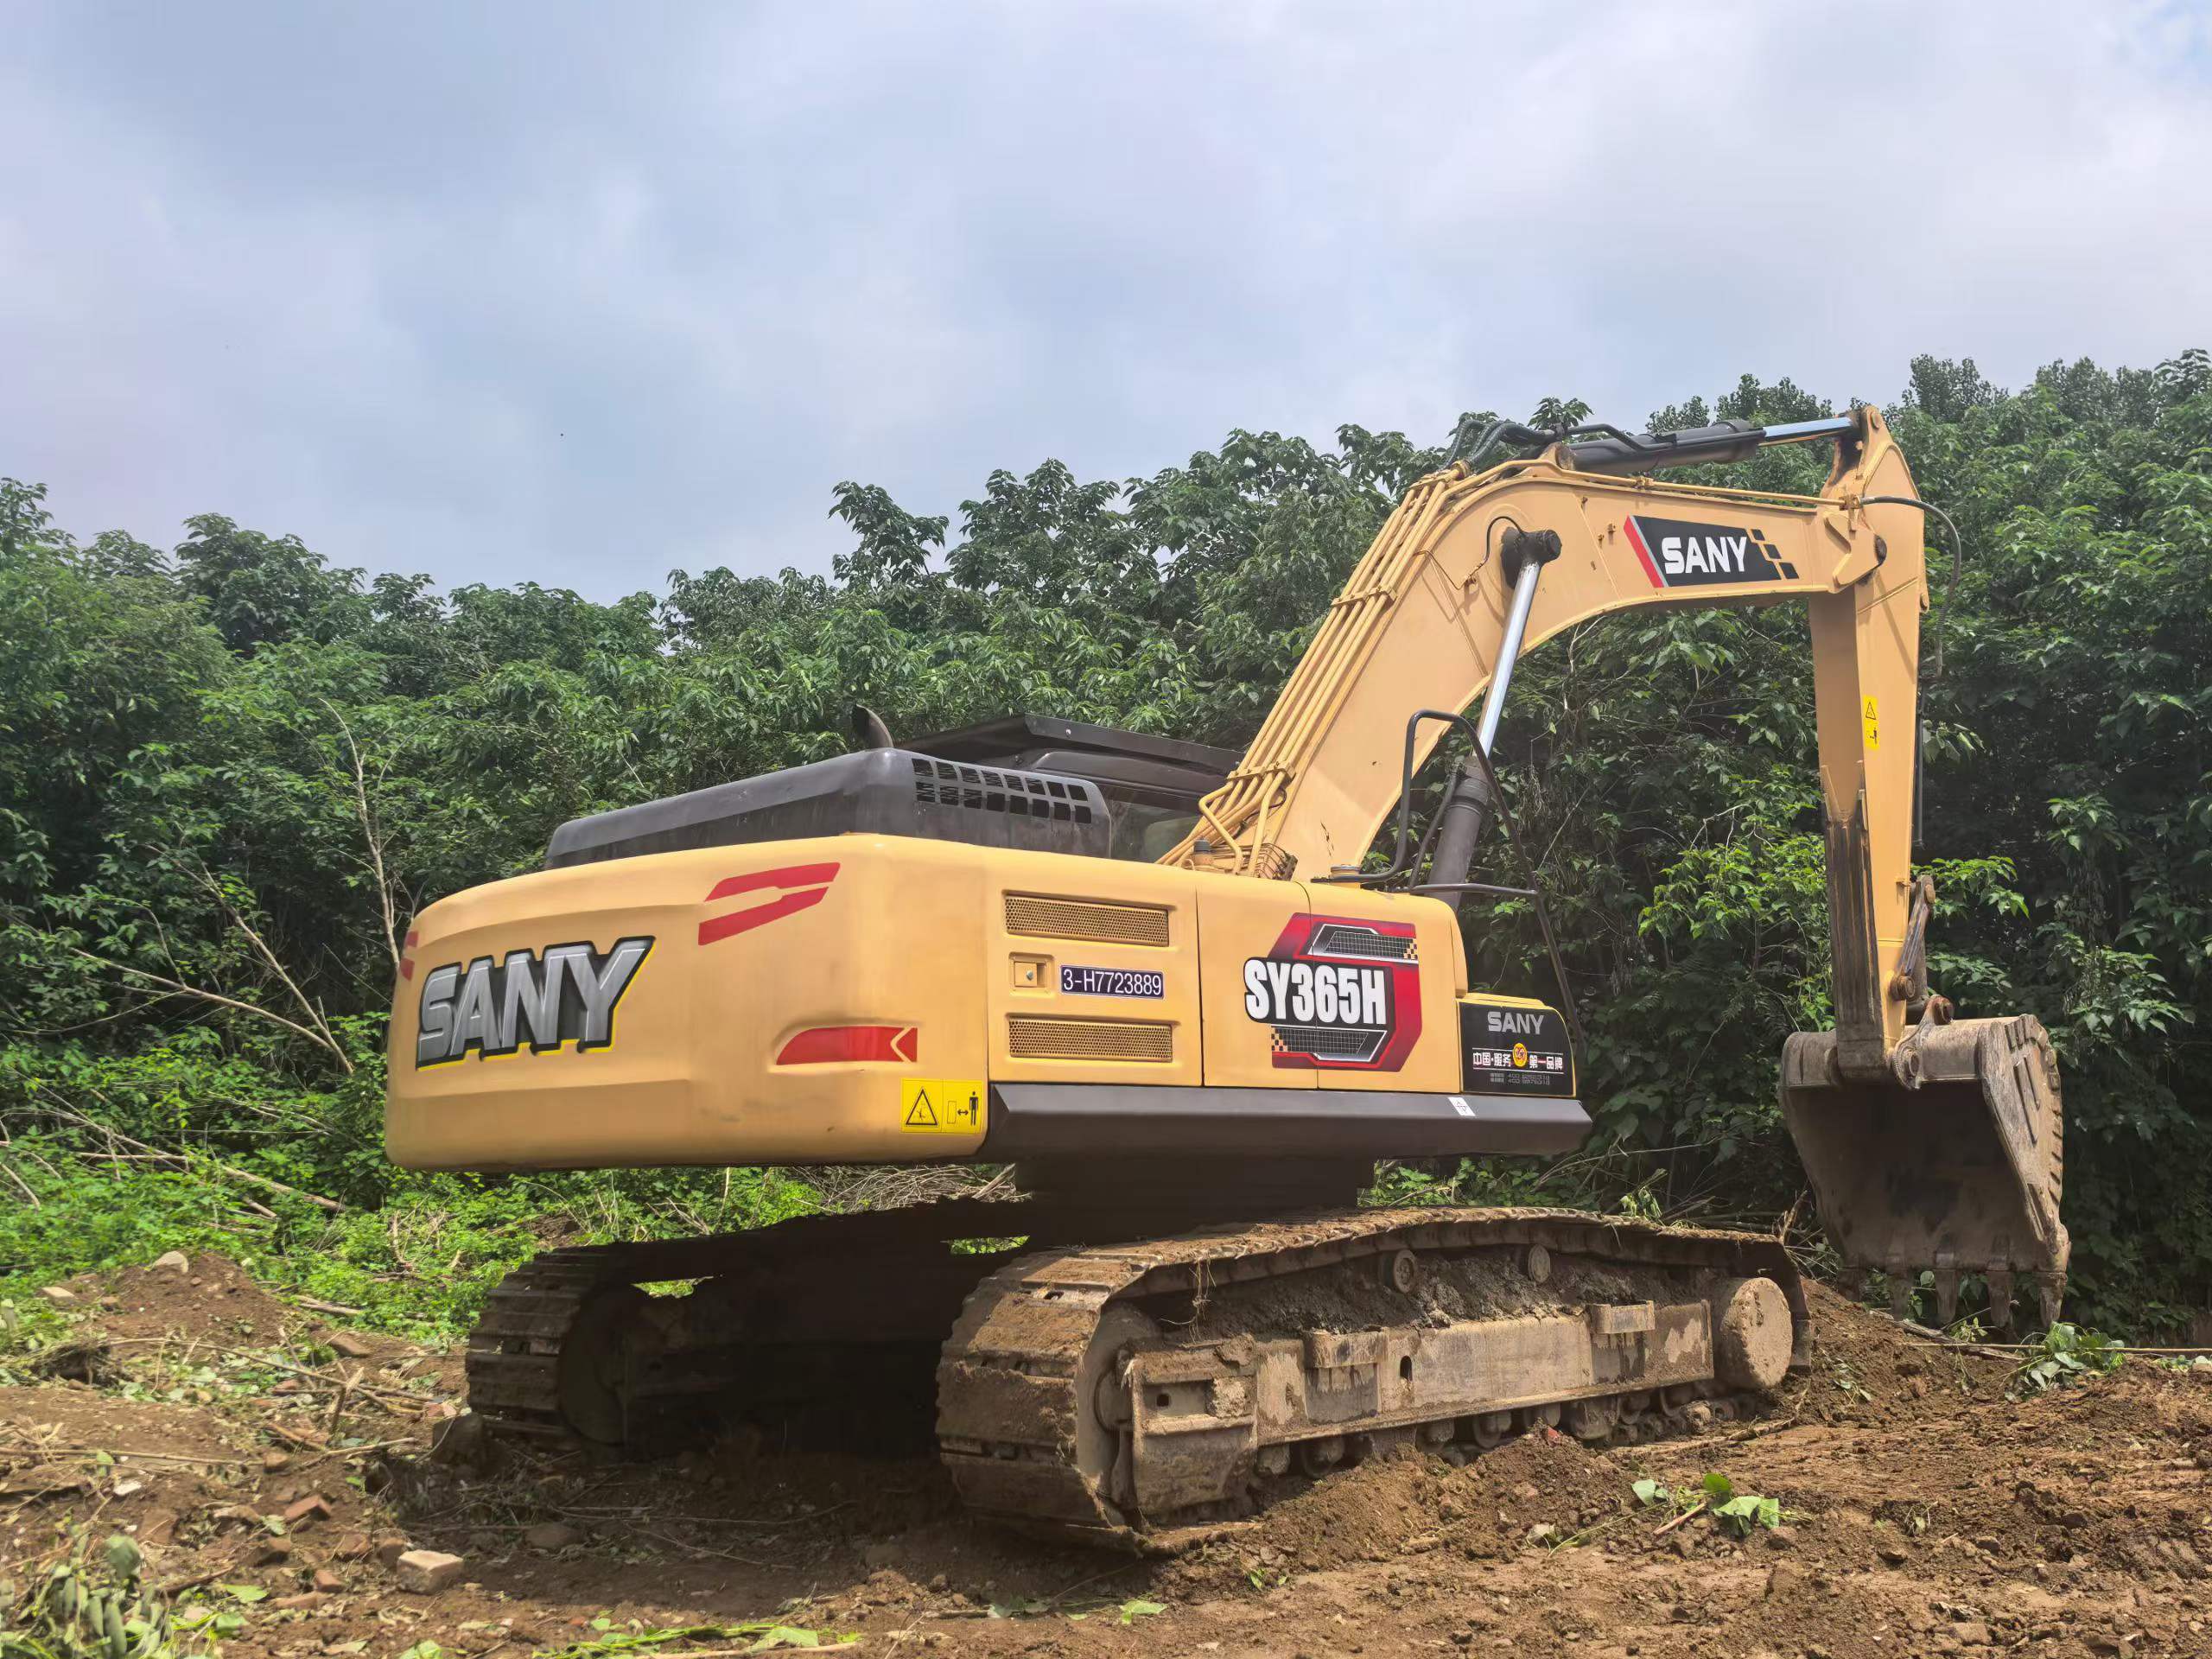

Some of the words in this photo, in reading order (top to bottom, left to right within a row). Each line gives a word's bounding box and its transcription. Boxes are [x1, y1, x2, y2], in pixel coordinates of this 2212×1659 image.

[1662, 536, 1747, 575] SANY
[1063, 968, 1162, 995] 3-H7723889
[1243, 958, 1387, 1025] SY365H
[416, 936, 654, 1069] SANY
[1487, 1011, 1545, 1035] SANY
